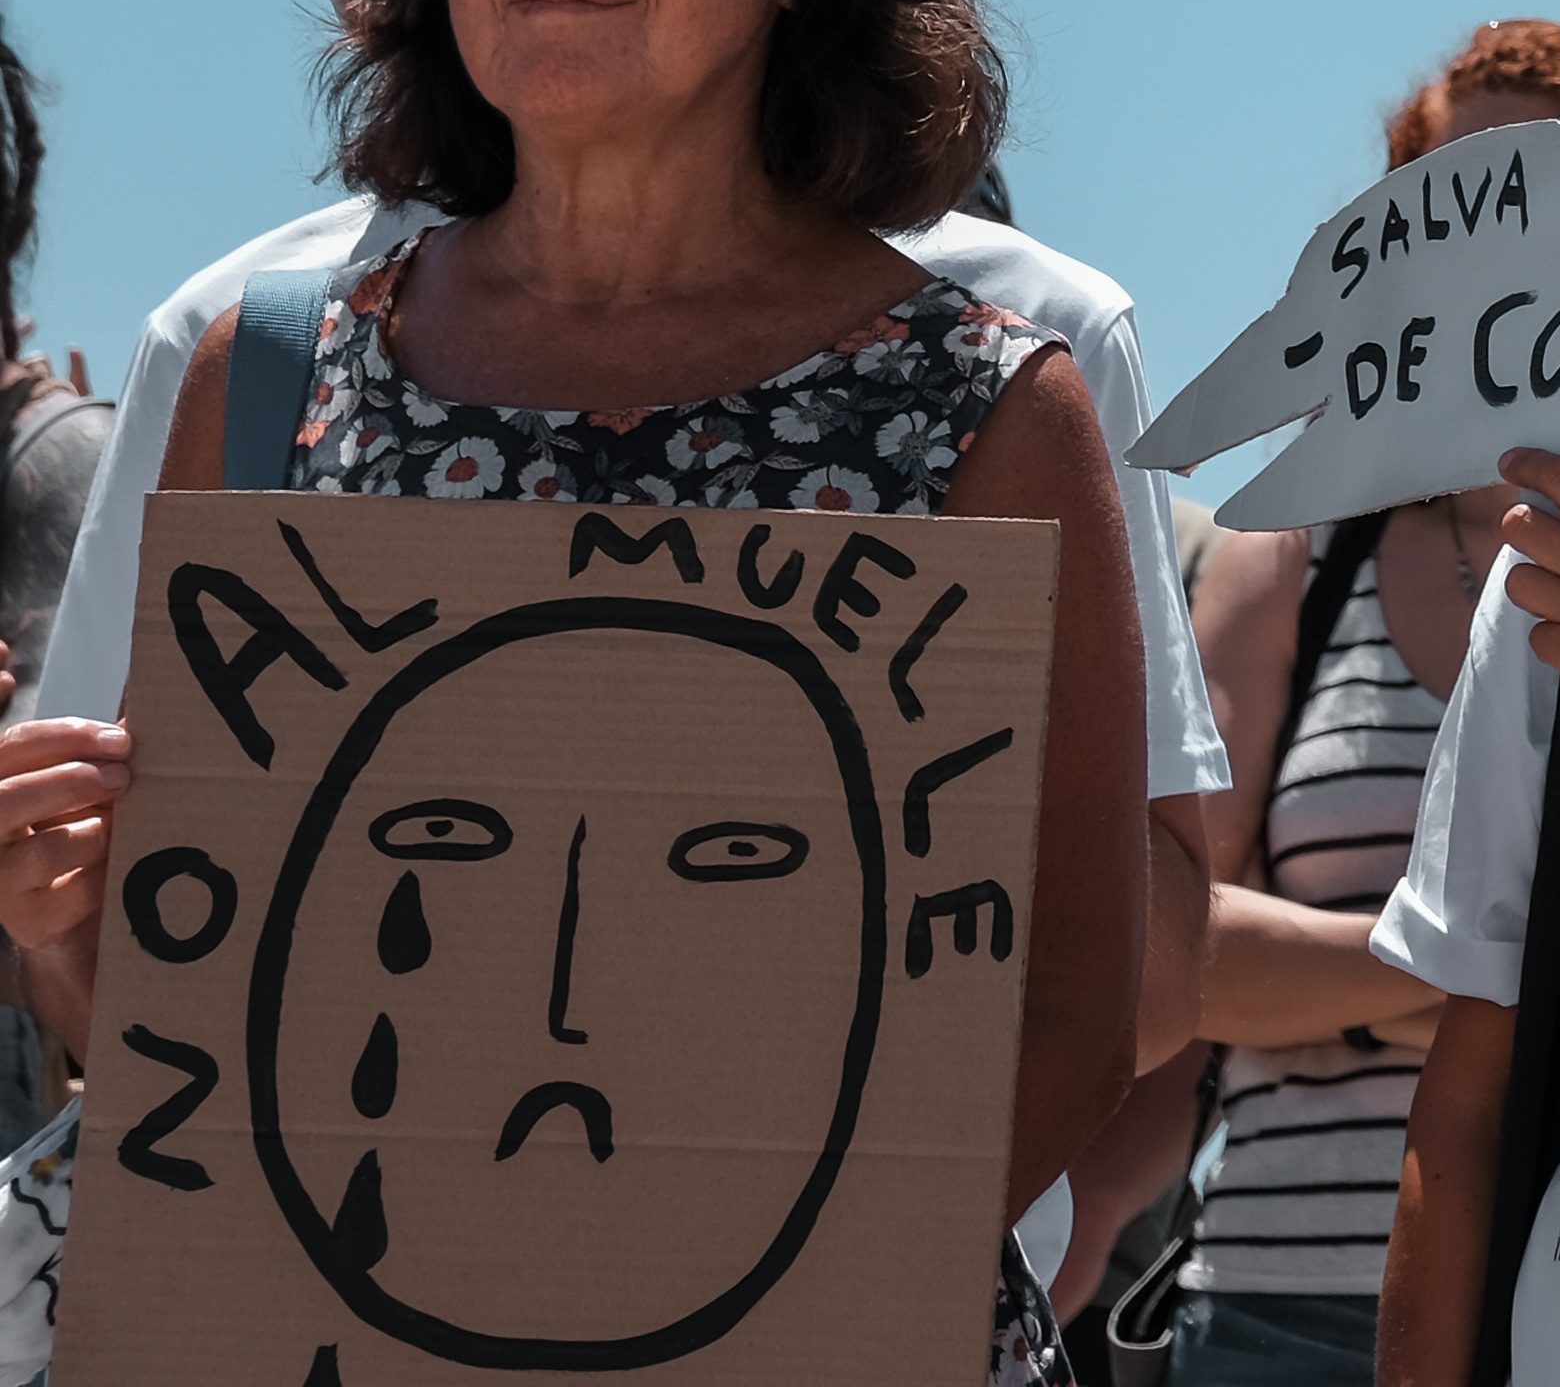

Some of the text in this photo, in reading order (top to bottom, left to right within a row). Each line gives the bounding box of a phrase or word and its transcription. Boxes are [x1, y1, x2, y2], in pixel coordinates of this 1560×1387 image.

[1330, 148, 1528, 299] SALVA
[118, 510, 1016, 1194] NO AL MUELLE
